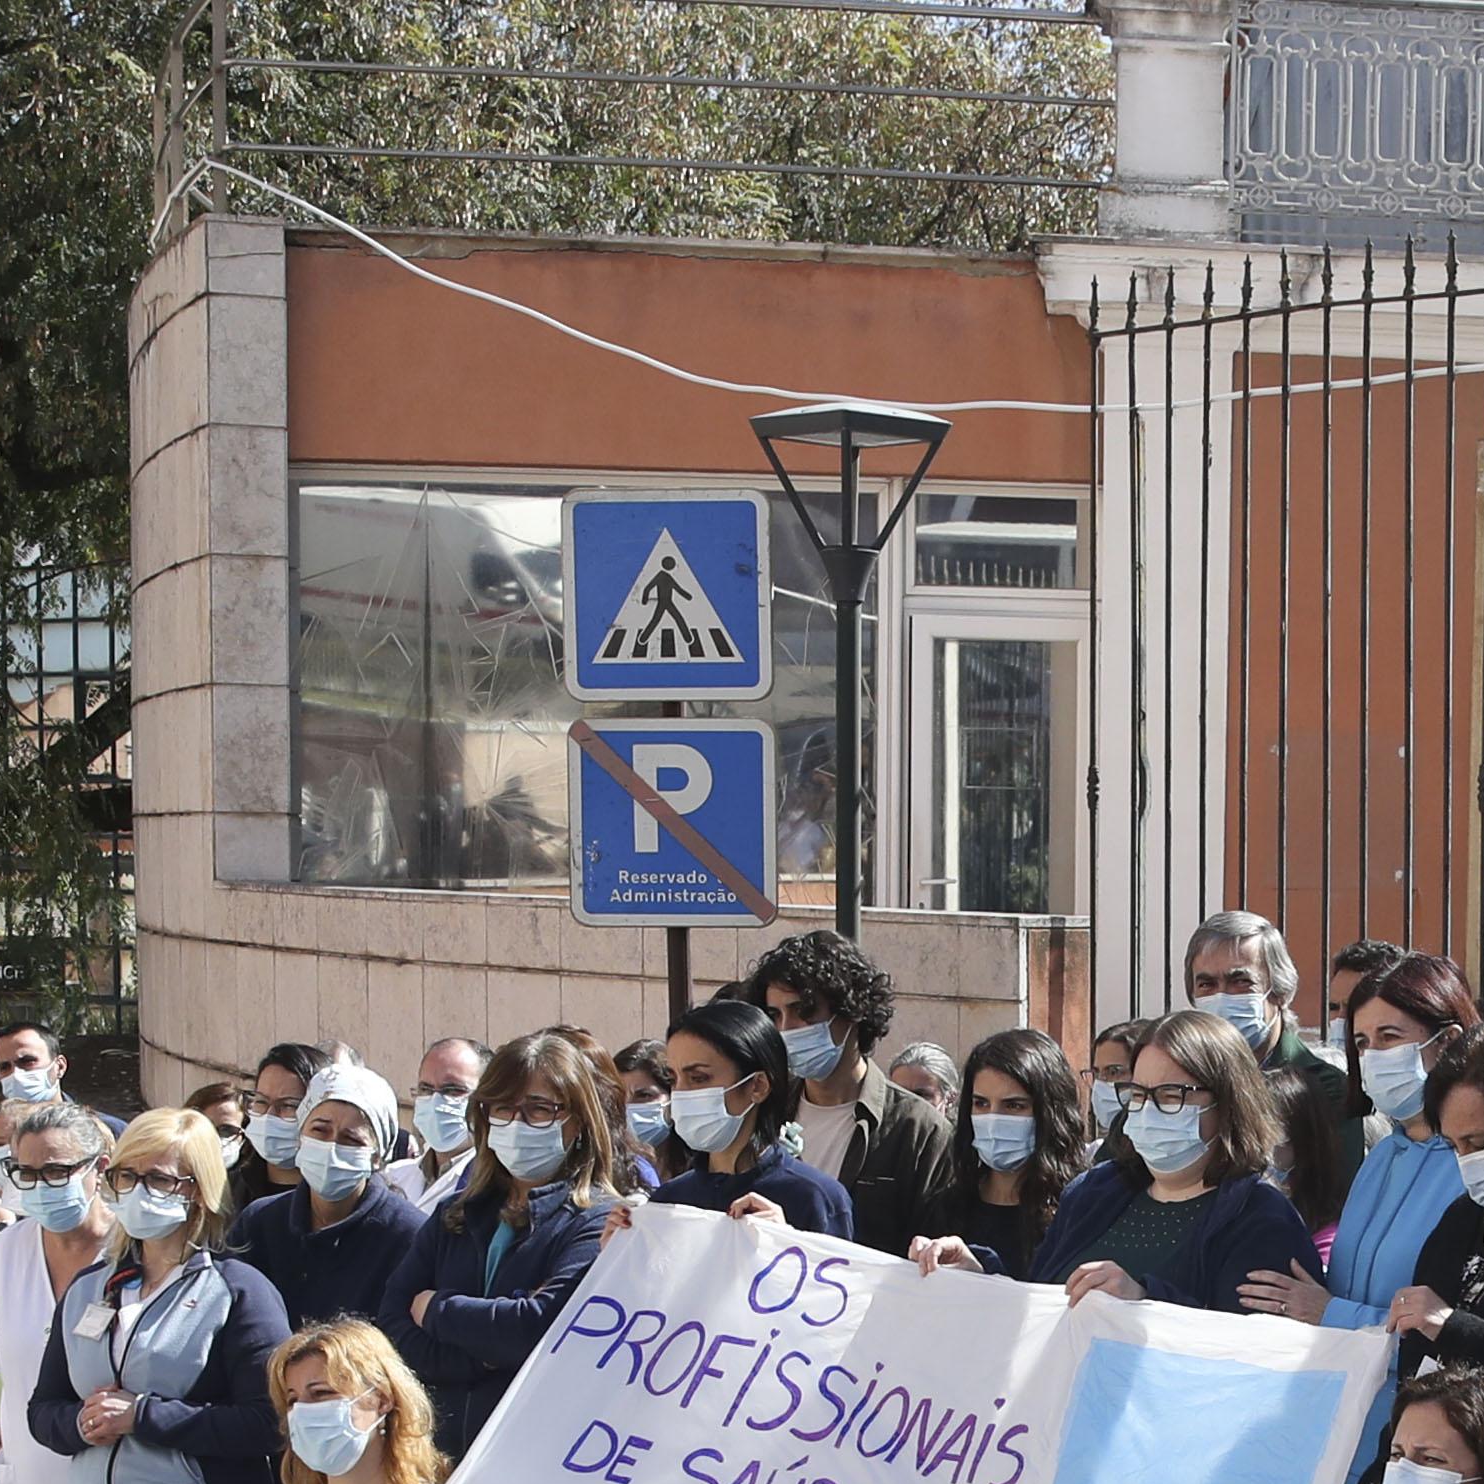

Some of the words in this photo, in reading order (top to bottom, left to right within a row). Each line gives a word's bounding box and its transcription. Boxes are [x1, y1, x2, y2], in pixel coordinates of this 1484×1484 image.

[632, 743, 713, 853] P
[610, 887, 738, 905] Administração
[618, 869, 708, 885] Reservado
[748, 1245, 851, 1327] OS
